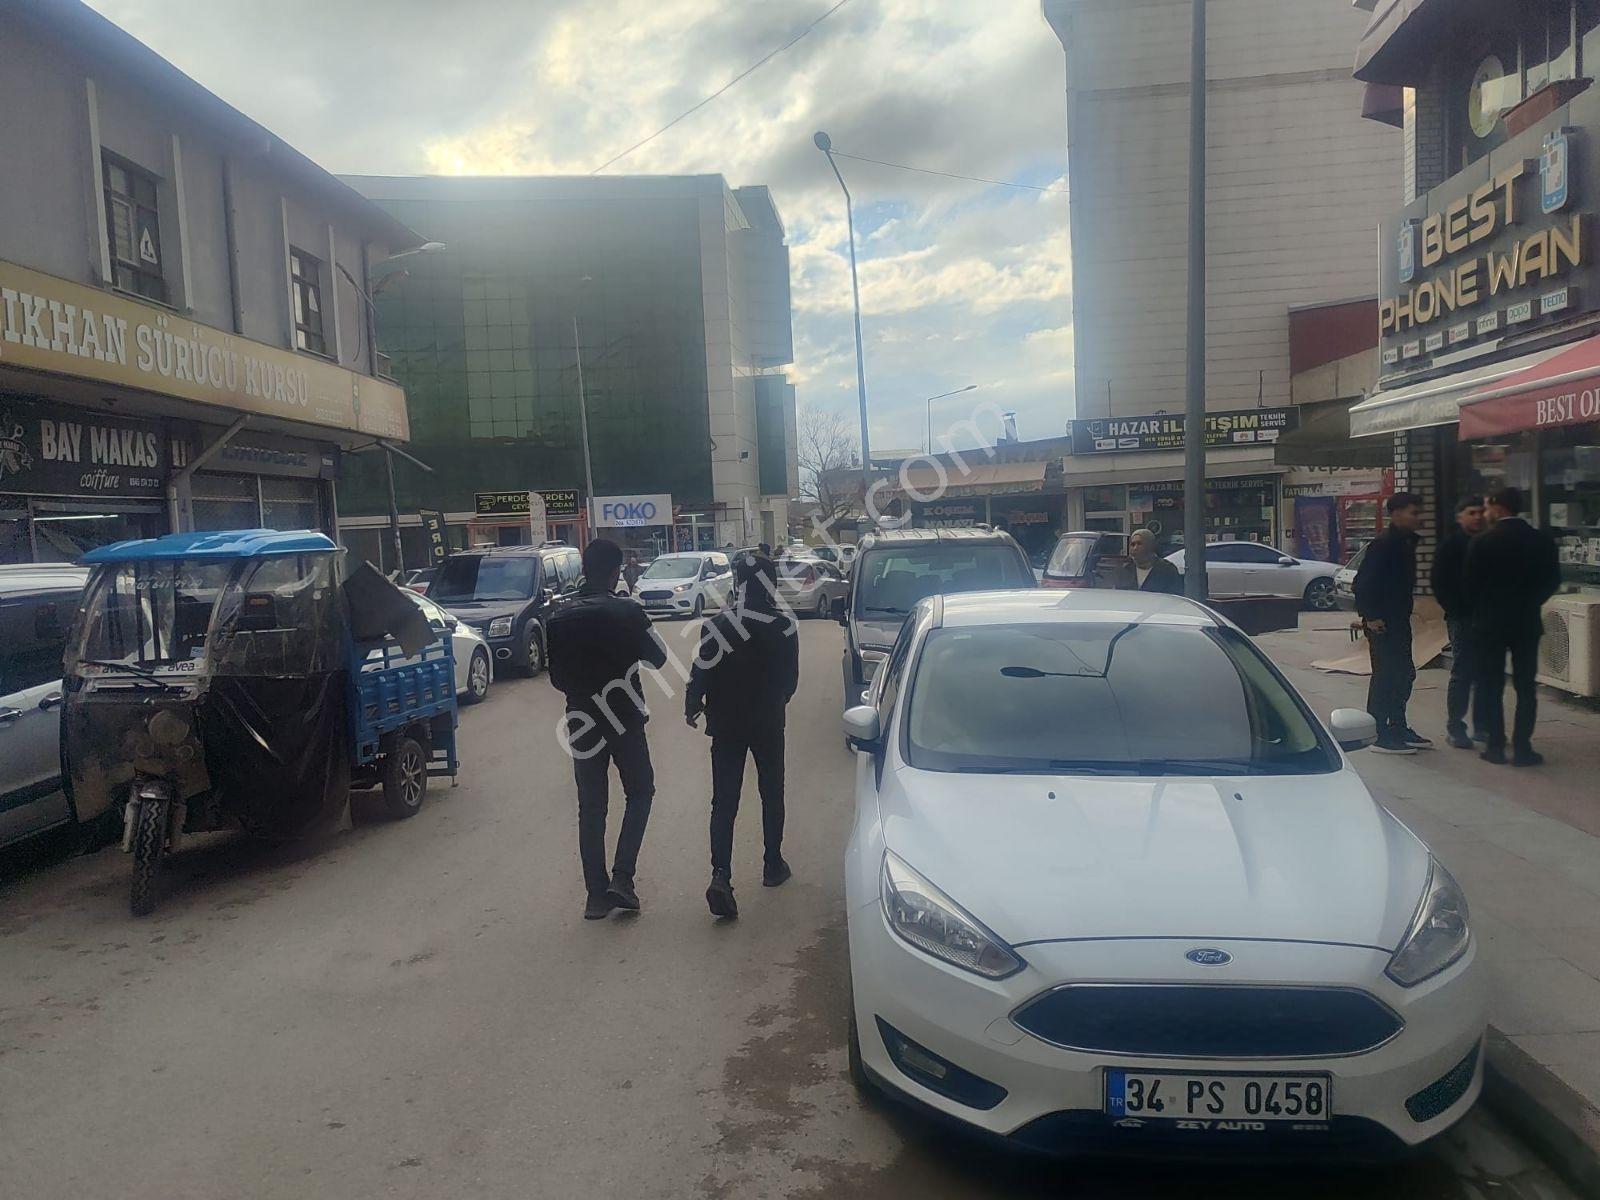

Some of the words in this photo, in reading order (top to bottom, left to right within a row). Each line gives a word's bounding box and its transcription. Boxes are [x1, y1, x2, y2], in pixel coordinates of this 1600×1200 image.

[1421, 158, 1526, 268] BEST
[1379, 257, 1477, 338] PHONE
[1487, 214, 1582, 296] WAN
[0, 287, 128, 366] IKHAN
[136, 315, 238, 392] SÜRÜCÜ
[244, 355, 311, 407] KURSU
[1536, 393, 1576, 426] BEST
[1108, 420, 1161, 436] HAZAR
[1163, 415, 1258, 433] İLTİŞİM
[41, 419, 83, 463] BAY
[90, 426, 158, 468] MAKAS
[80, 469, 121, 490] coiffure
[1284, 487, 1314, 498] FATURA
[602, 502, 657, 520] FOKO
[167, 662, 195, 672] avea
[1196, 951, 1222, 962] Ford
[1109, 1096, 1123, 1108] TR
[1126, 1078, 1164, 1112] 34
[1187, 1080, 1226, 1115] PS
[1244, 1081, 1323, 1116] 0458
[1175, 1120, 1214, 1131] ZEY
[1216, 1121, 1266, 1131] AUTO
